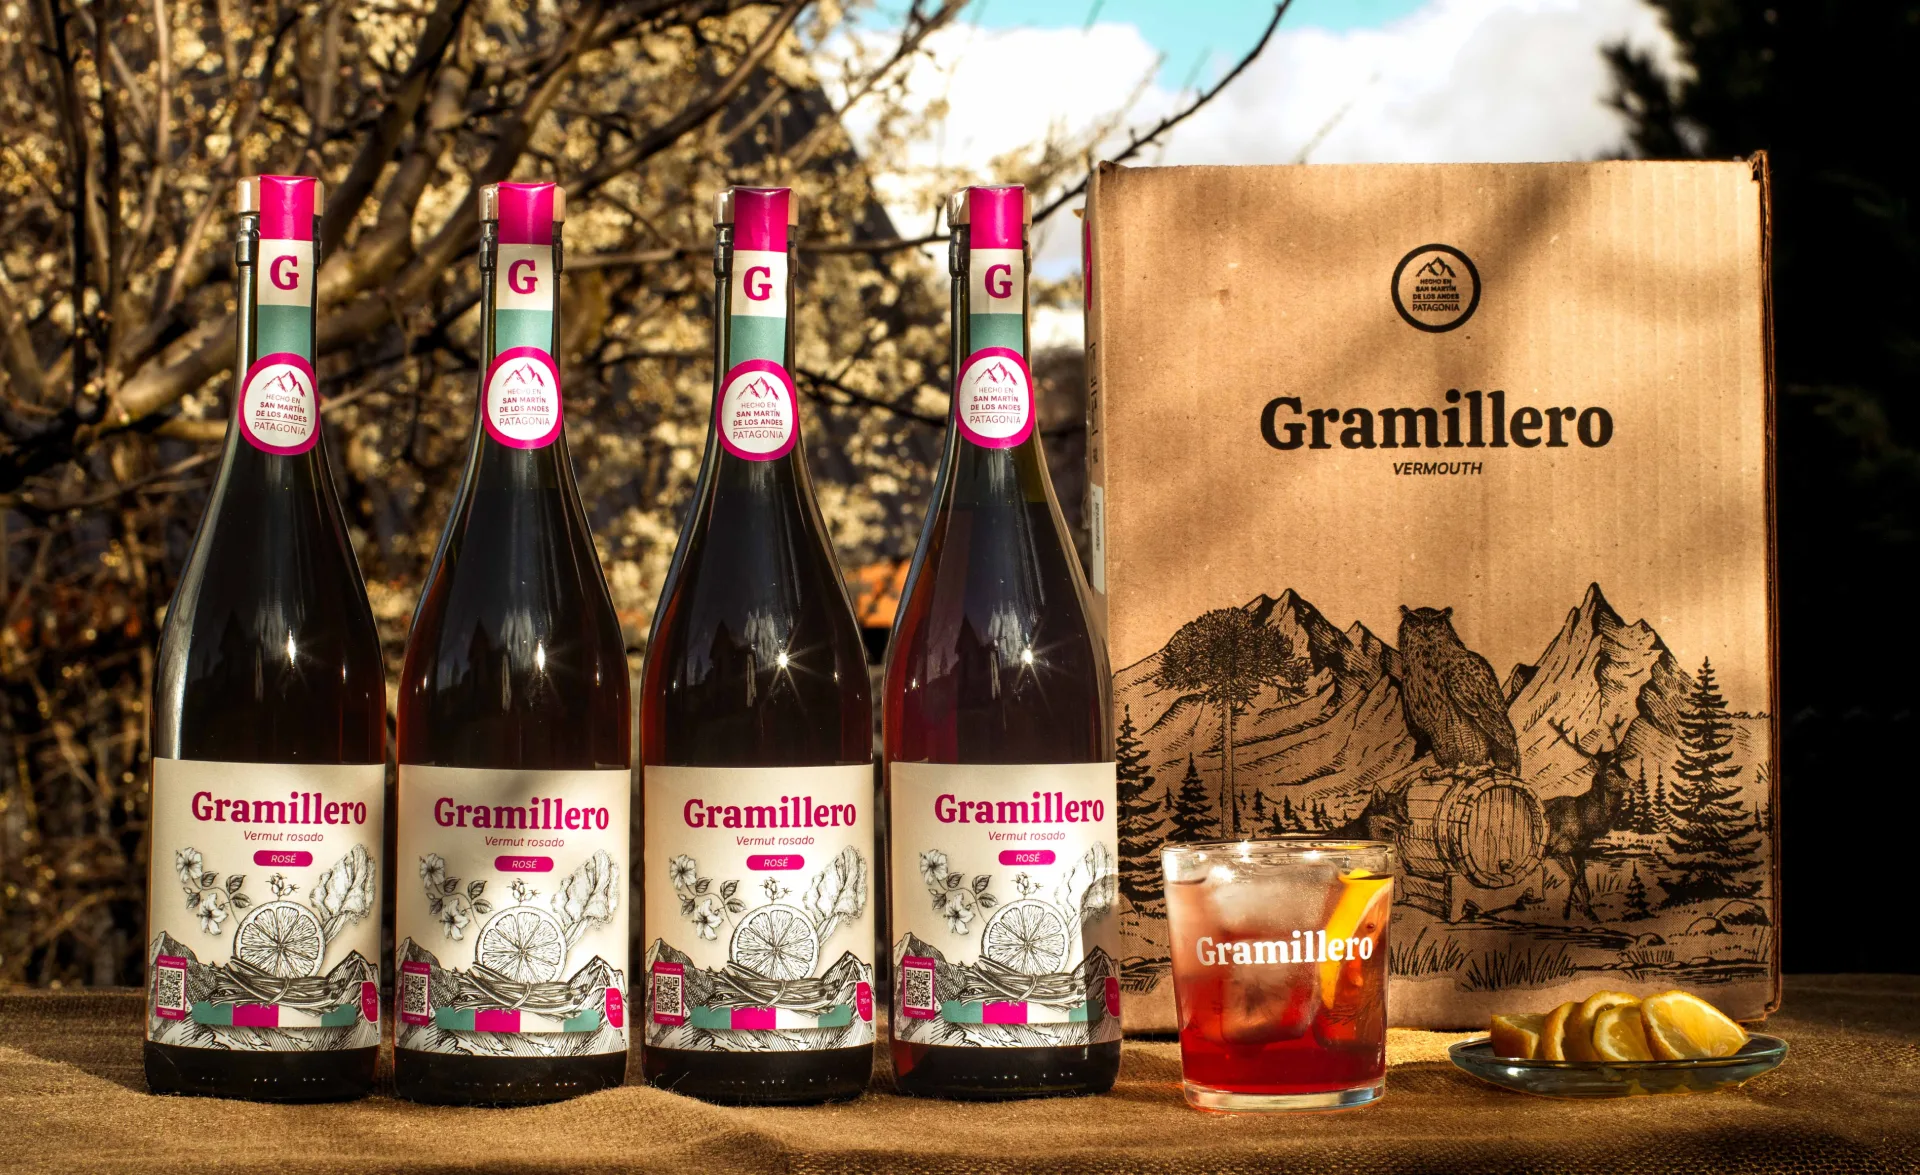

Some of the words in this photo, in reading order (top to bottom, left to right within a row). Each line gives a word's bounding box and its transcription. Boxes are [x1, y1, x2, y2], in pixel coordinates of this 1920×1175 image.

[270, 256, 300, 290] G
[508, 259, 538, 294] G
[743, 266, 773, 301] G
[984, 264, 1012, 299] G
[1412, 303, 1460, 312] PATAGONIA
[266, 393, 290, 402] HECHO
[283, 413, 307, 422] ANDES
[500, 416, 550, 426] PATAGONIA
[970, 414, 1021, 424] PATAGONIA
[1260, 388, 1614, 450] Gramillero
[254, 422, 306, 436] PATAGONIA
[732, 430, 784, 439] PATAGONIA
[1393, 462, 1482, 476] VERMOUTH
[192, 791, 366, 824] Gramillero
[434, 797, 610, 830] Gramillero
[684, 796, 857, 828] Gramillero
[934, 792, 1104, 824] Gramillero
[244, 830, 283, 842] Vermut
[286, 832, 324, 842] rosado
[736, 836, 775, 846] Vermut
[778, 835, 814, 846] rosado
[988, 830, 1028, 841] Vermut
[1030, 830, 1066, 841] rosado
[485, 836, 524, 846] Vermut
[528, 838, 564, 848] rosado
[270, 854, 297, 864] ROSÉ
[512, 858, 538, 869] ROSÉ
[764, 857, 788, 868] ROSÉ
[1016, 852, 1040, 863] ROSÉ
[1196, 930, 1373, 966] Gramillero
